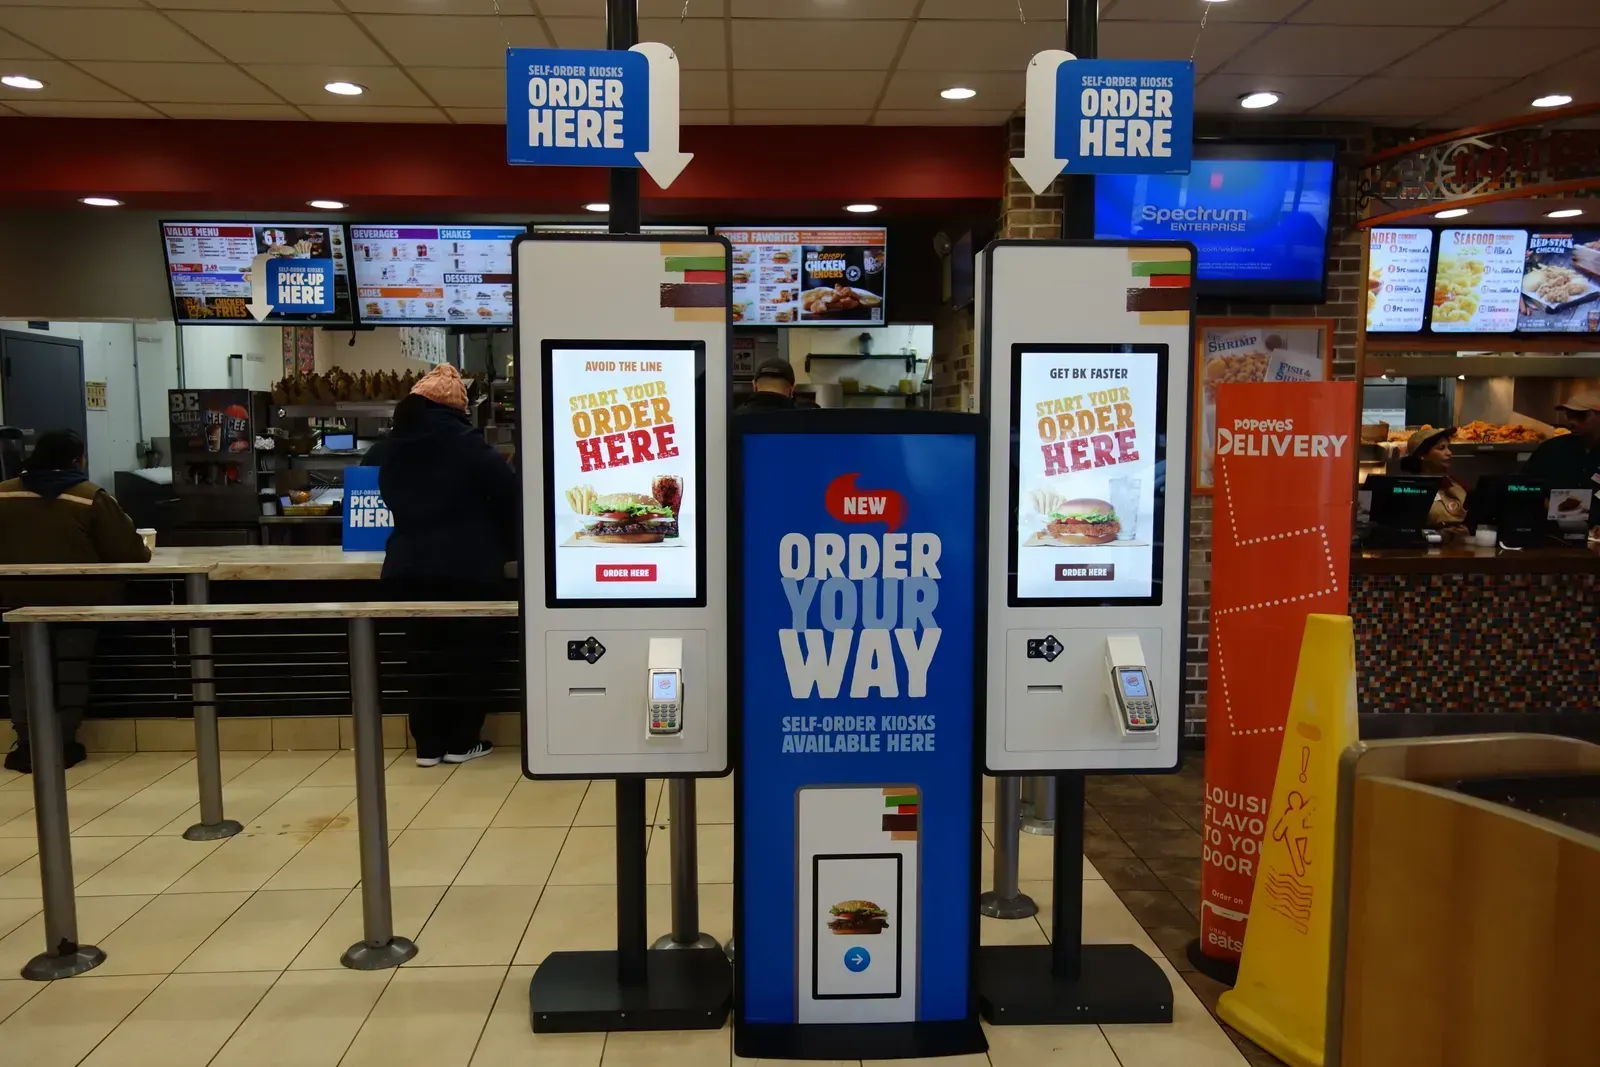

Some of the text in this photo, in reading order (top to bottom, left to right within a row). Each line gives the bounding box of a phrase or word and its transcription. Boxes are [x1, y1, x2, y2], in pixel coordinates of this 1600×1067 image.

[528, 65, 624, 78] SELF-ORDER KIOSKS
[1081, 76, 1174, 88] SELF-ORDER KIOSKS
[528, 77, 624, 108] ORDER
[1080, 88, 1173, 117] ORDER
[528, 109, 624, 149] HERE
[1079, 119, 1173, 157] HERE
[1141, 204, 1249, 224] Spectrum
[166, 227, 220, 237] VALUE MENU
[353, 229, 399, 239] BEVERAGES
[441, 230, 471, 239] SHAKES
[1170, 222, 1246, 232] ENTERPRISE
[751, 232, 799, 242] FAVORITES
[1453, 231, 1495, 245] SEAFOOD
[805, 259, 846, 271] CHICKEN
[818, 252, 845, 260] CRISPY
[278, 272, 325, 286] PICK-UP
[444, 274, 483, 283] DESSERTS
[810, 270, 844, 279] TENDERS
[278, 285, 325, 304] HERE
[359, 288, 382, 297] SIDES
[215, 298, 245, 307] CHICKEN
[216, 306, 248, 318] FRIES
[1207, 336, 1257, 353] SHRIMP
[585, 361, 662, 372] AVOID THE LINE
[1049, 368, 1128, 379] GET BK FASTER
[1278, 361, 1311, 378] FISH &
[170, 392, 200, 412] BE
[569, 380, 668, 411] START YOUR
[1035, 386, 1130, 417] START YOUR
[171, 411, 201, 423] CHILL
[571, 397, 673, 438] ORDER
[1037, 402, 1135, 443] ORDER
[576, 423, 680, 473] HERE
[1216, 428, 1348, 457] DELIVERY
[1040, 428, 1139, 477] HERE
[843, 496, 887, 515] NEW
[778, 532, 942, 581] ORDER
[603, 568, 650, 578] ORDER HERE
[1062, 567, 1108, 577] ORDER HERE
[780, 576, 940, 633] YOUR
[778, 628, 942, 699] WAY
[781, 714, 936, 732] SELF-ORDER KIOSKS
[781, 733, 936, 753] AVAILABLE HERE
[1206, 782, 1267, 815] LOUISI
[1205, 803, 1264, 835] FLAVO
[1204, 823, 1222, 846] TO
[1203, 843, 1253, 876] DOOR
[1211, 888, 1244, 906] Order on
[1207, 931, 1243, 953] eats
